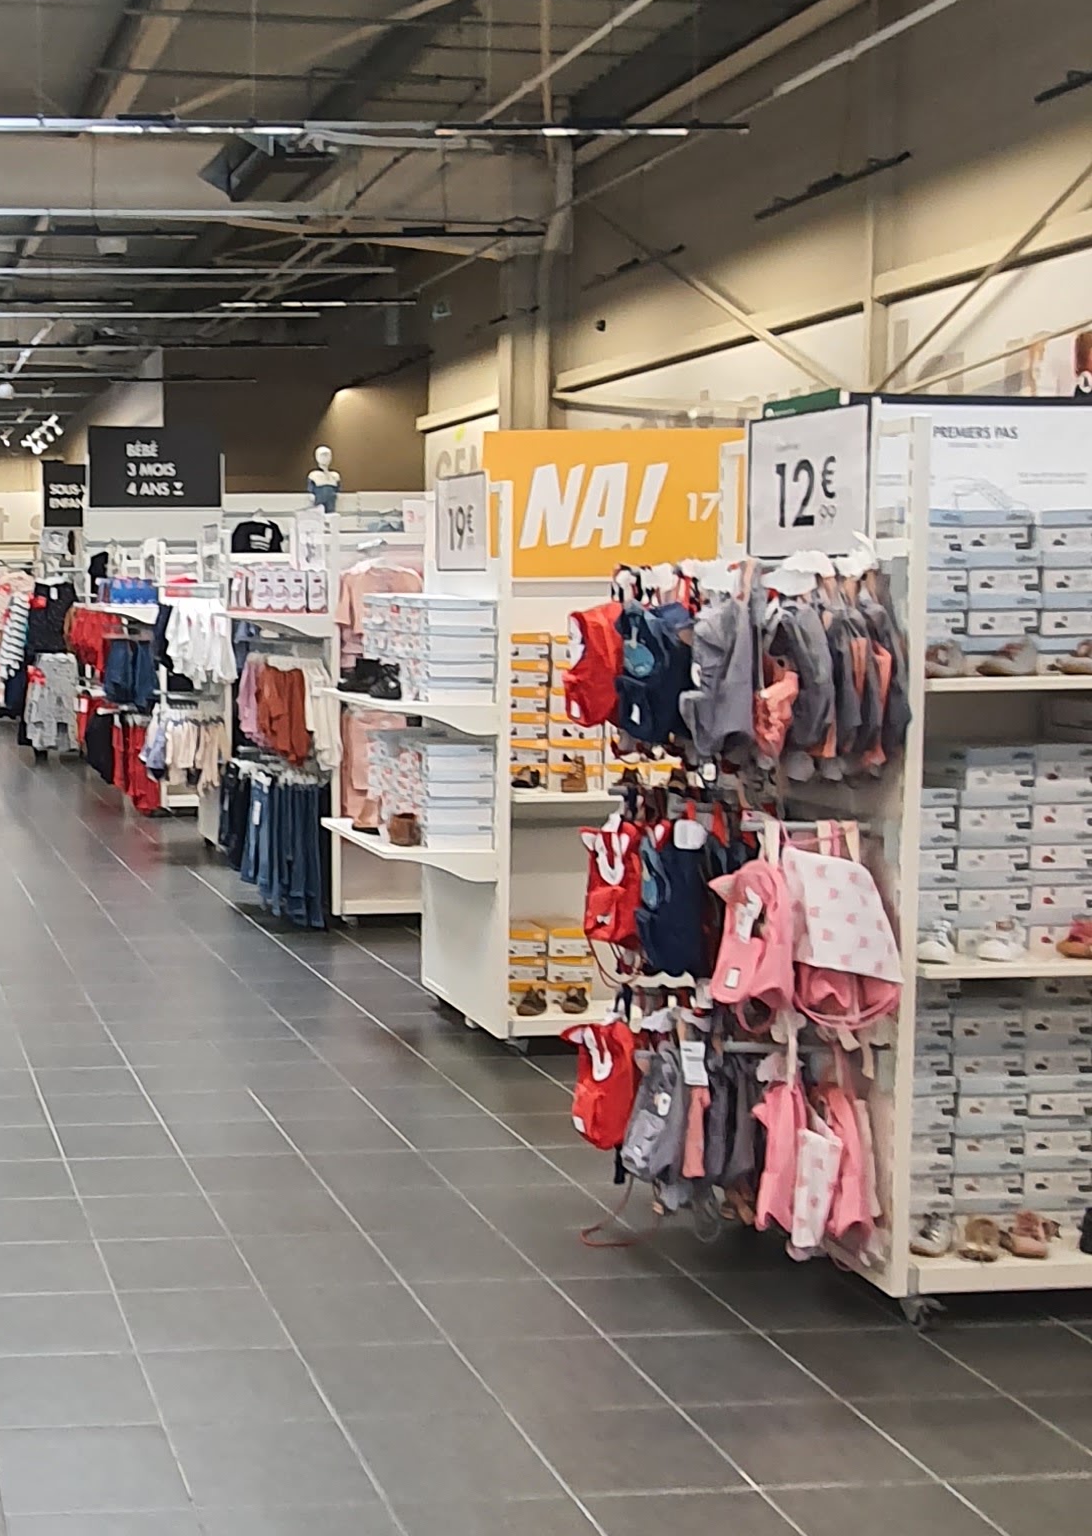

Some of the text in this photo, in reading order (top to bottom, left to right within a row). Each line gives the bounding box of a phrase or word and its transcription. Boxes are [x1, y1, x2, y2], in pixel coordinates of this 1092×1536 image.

[994, 426, 1019, 440] PAS
[127, 462, 176, 477] 3 MOIS
[126, 481, 170, 496] 4 ANS
[519, 462, 669, 549] NA!
